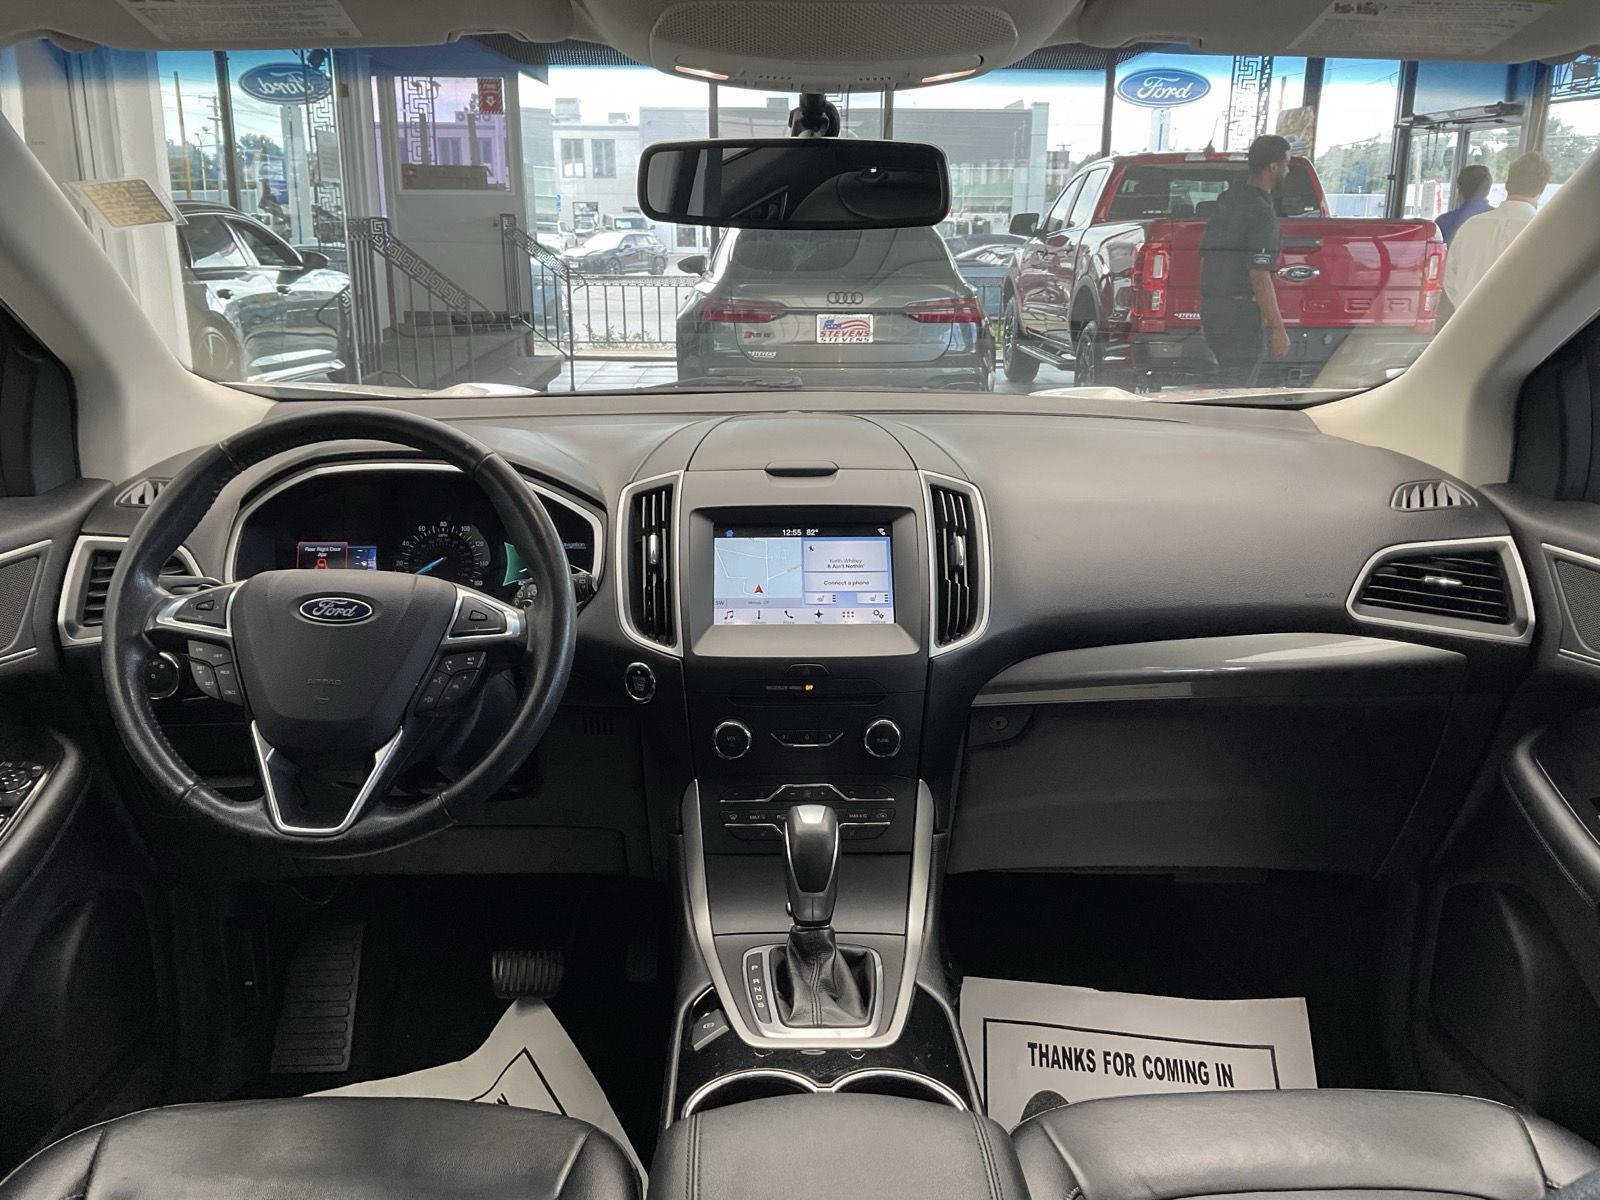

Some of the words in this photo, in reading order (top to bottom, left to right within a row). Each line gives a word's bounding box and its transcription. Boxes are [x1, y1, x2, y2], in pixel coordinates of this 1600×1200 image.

[1136, 76, 1194, 99] Ford
[312, 599, 358, 617] Ford
[1027, 1042, 1096, 1073] THANKS
[1103, 1053, 1137, 1078] FOR
[1142, 1055, 1210, 1086] COMING
[1215, 1062, 1235, 1089] IN
